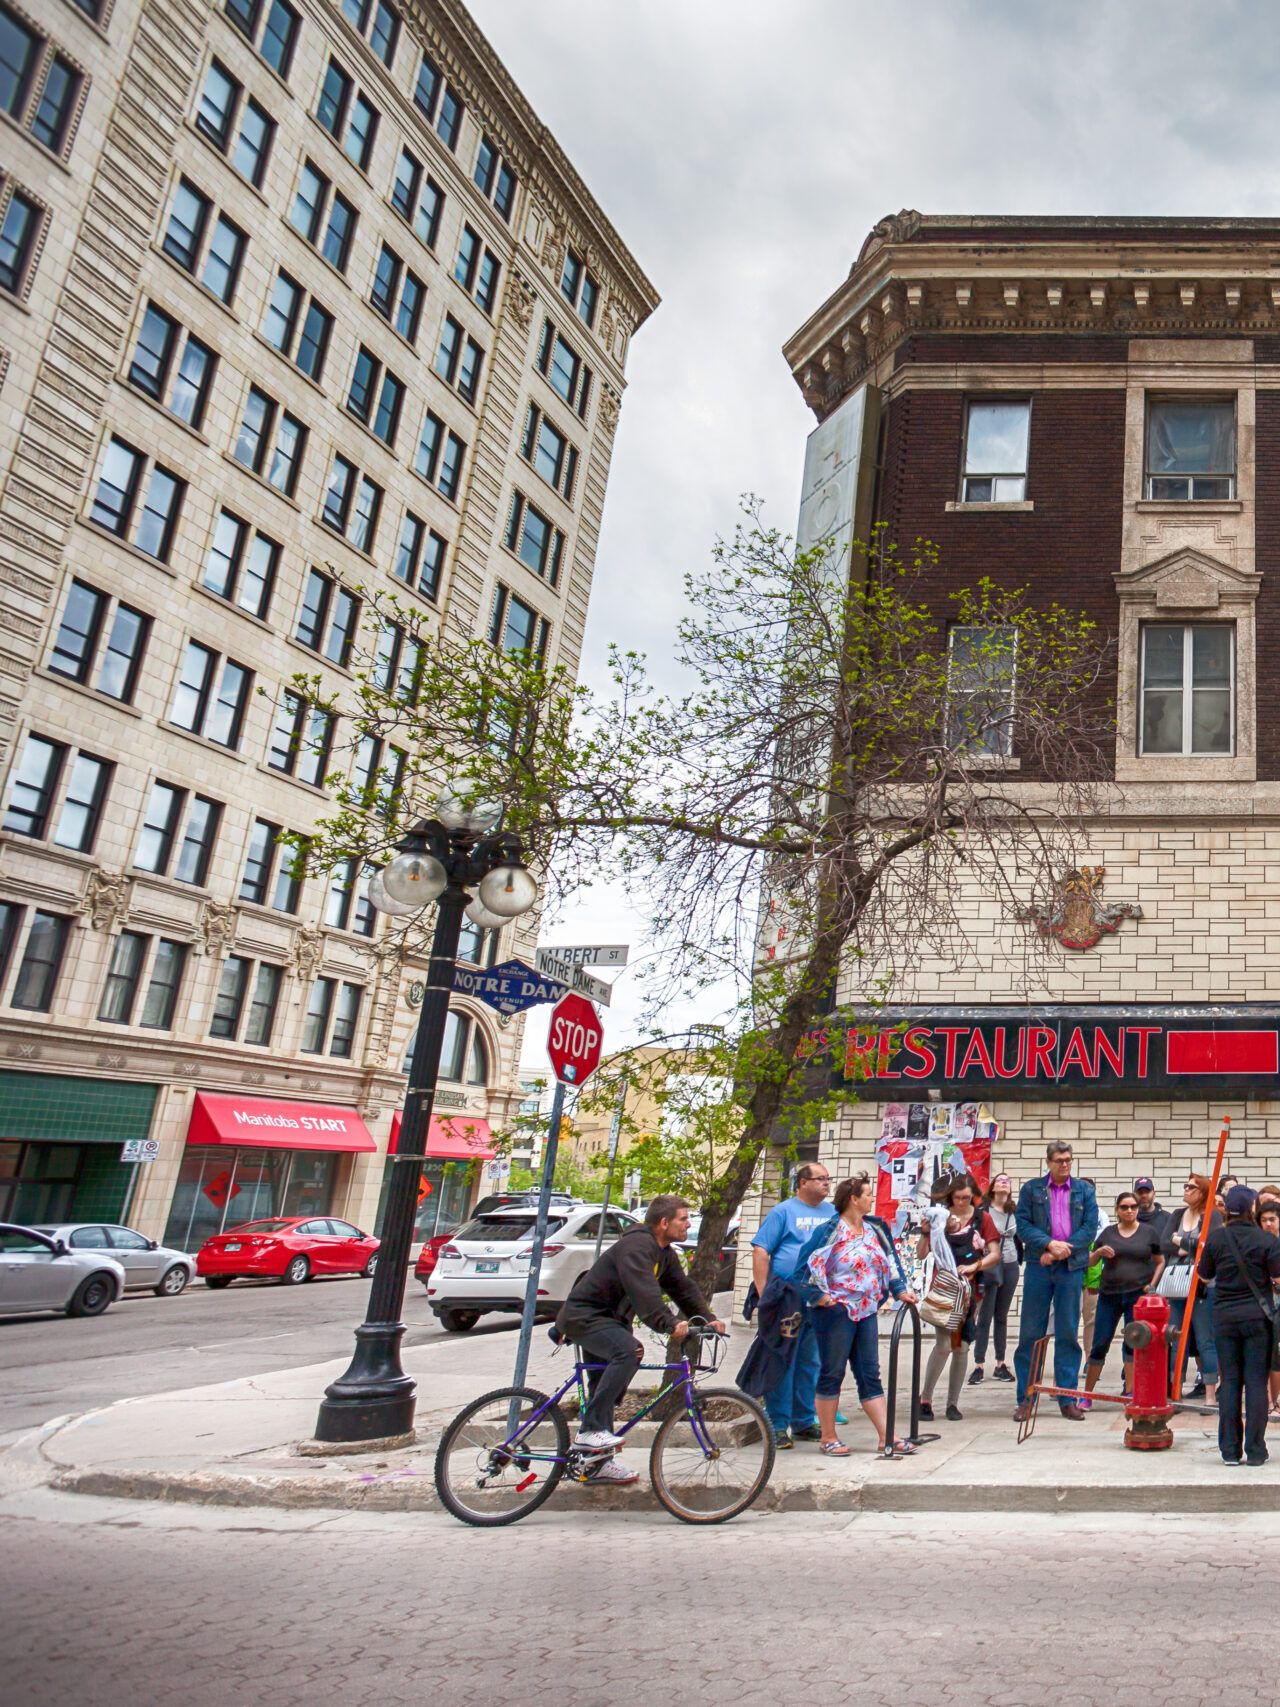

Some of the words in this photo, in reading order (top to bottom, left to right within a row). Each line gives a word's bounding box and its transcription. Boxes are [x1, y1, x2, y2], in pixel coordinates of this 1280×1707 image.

[548, 947, 602, 965] BERT
[608, 950, 620, 960] ST
[453, 971, 511, 994] NOTRE
[520, 980, 568, 1000] DAM
[539, 953, 571, 983] NOTRE
[572, 968, 596, 996] DAME
[492, 995, 525, 1005] AVENUE
[552, 1016, 598, 1060] STOP
[844, 1027, 1162, 1078] RESTAURANT
[233, 1110, 299, 1128] Manitoba
[300, 1117, 347, 1132] START
